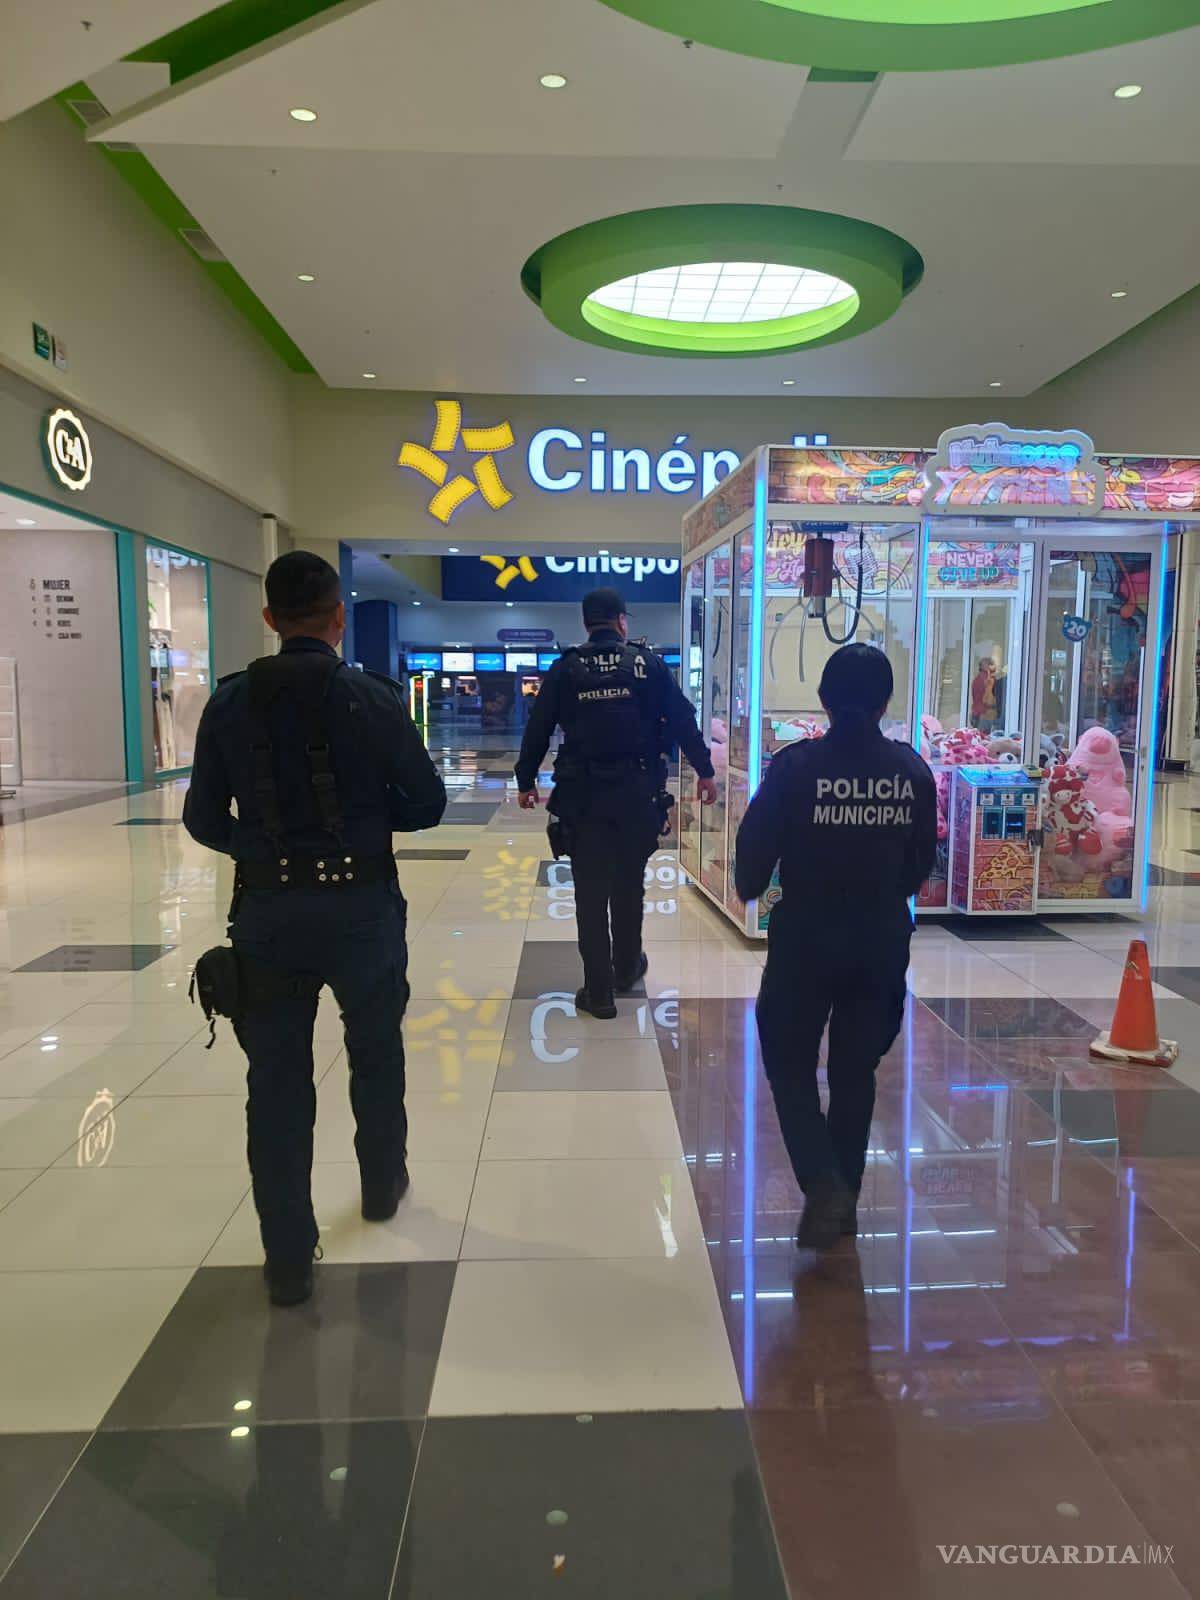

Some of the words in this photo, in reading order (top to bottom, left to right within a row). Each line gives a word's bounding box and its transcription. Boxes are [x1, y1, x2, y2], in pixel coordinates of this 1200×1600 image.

[946, 551, 994, 567] NEVER
[816, 773, 916, 800] POLICÍA
[812, 805, 913, 825] MUNICIPAL
